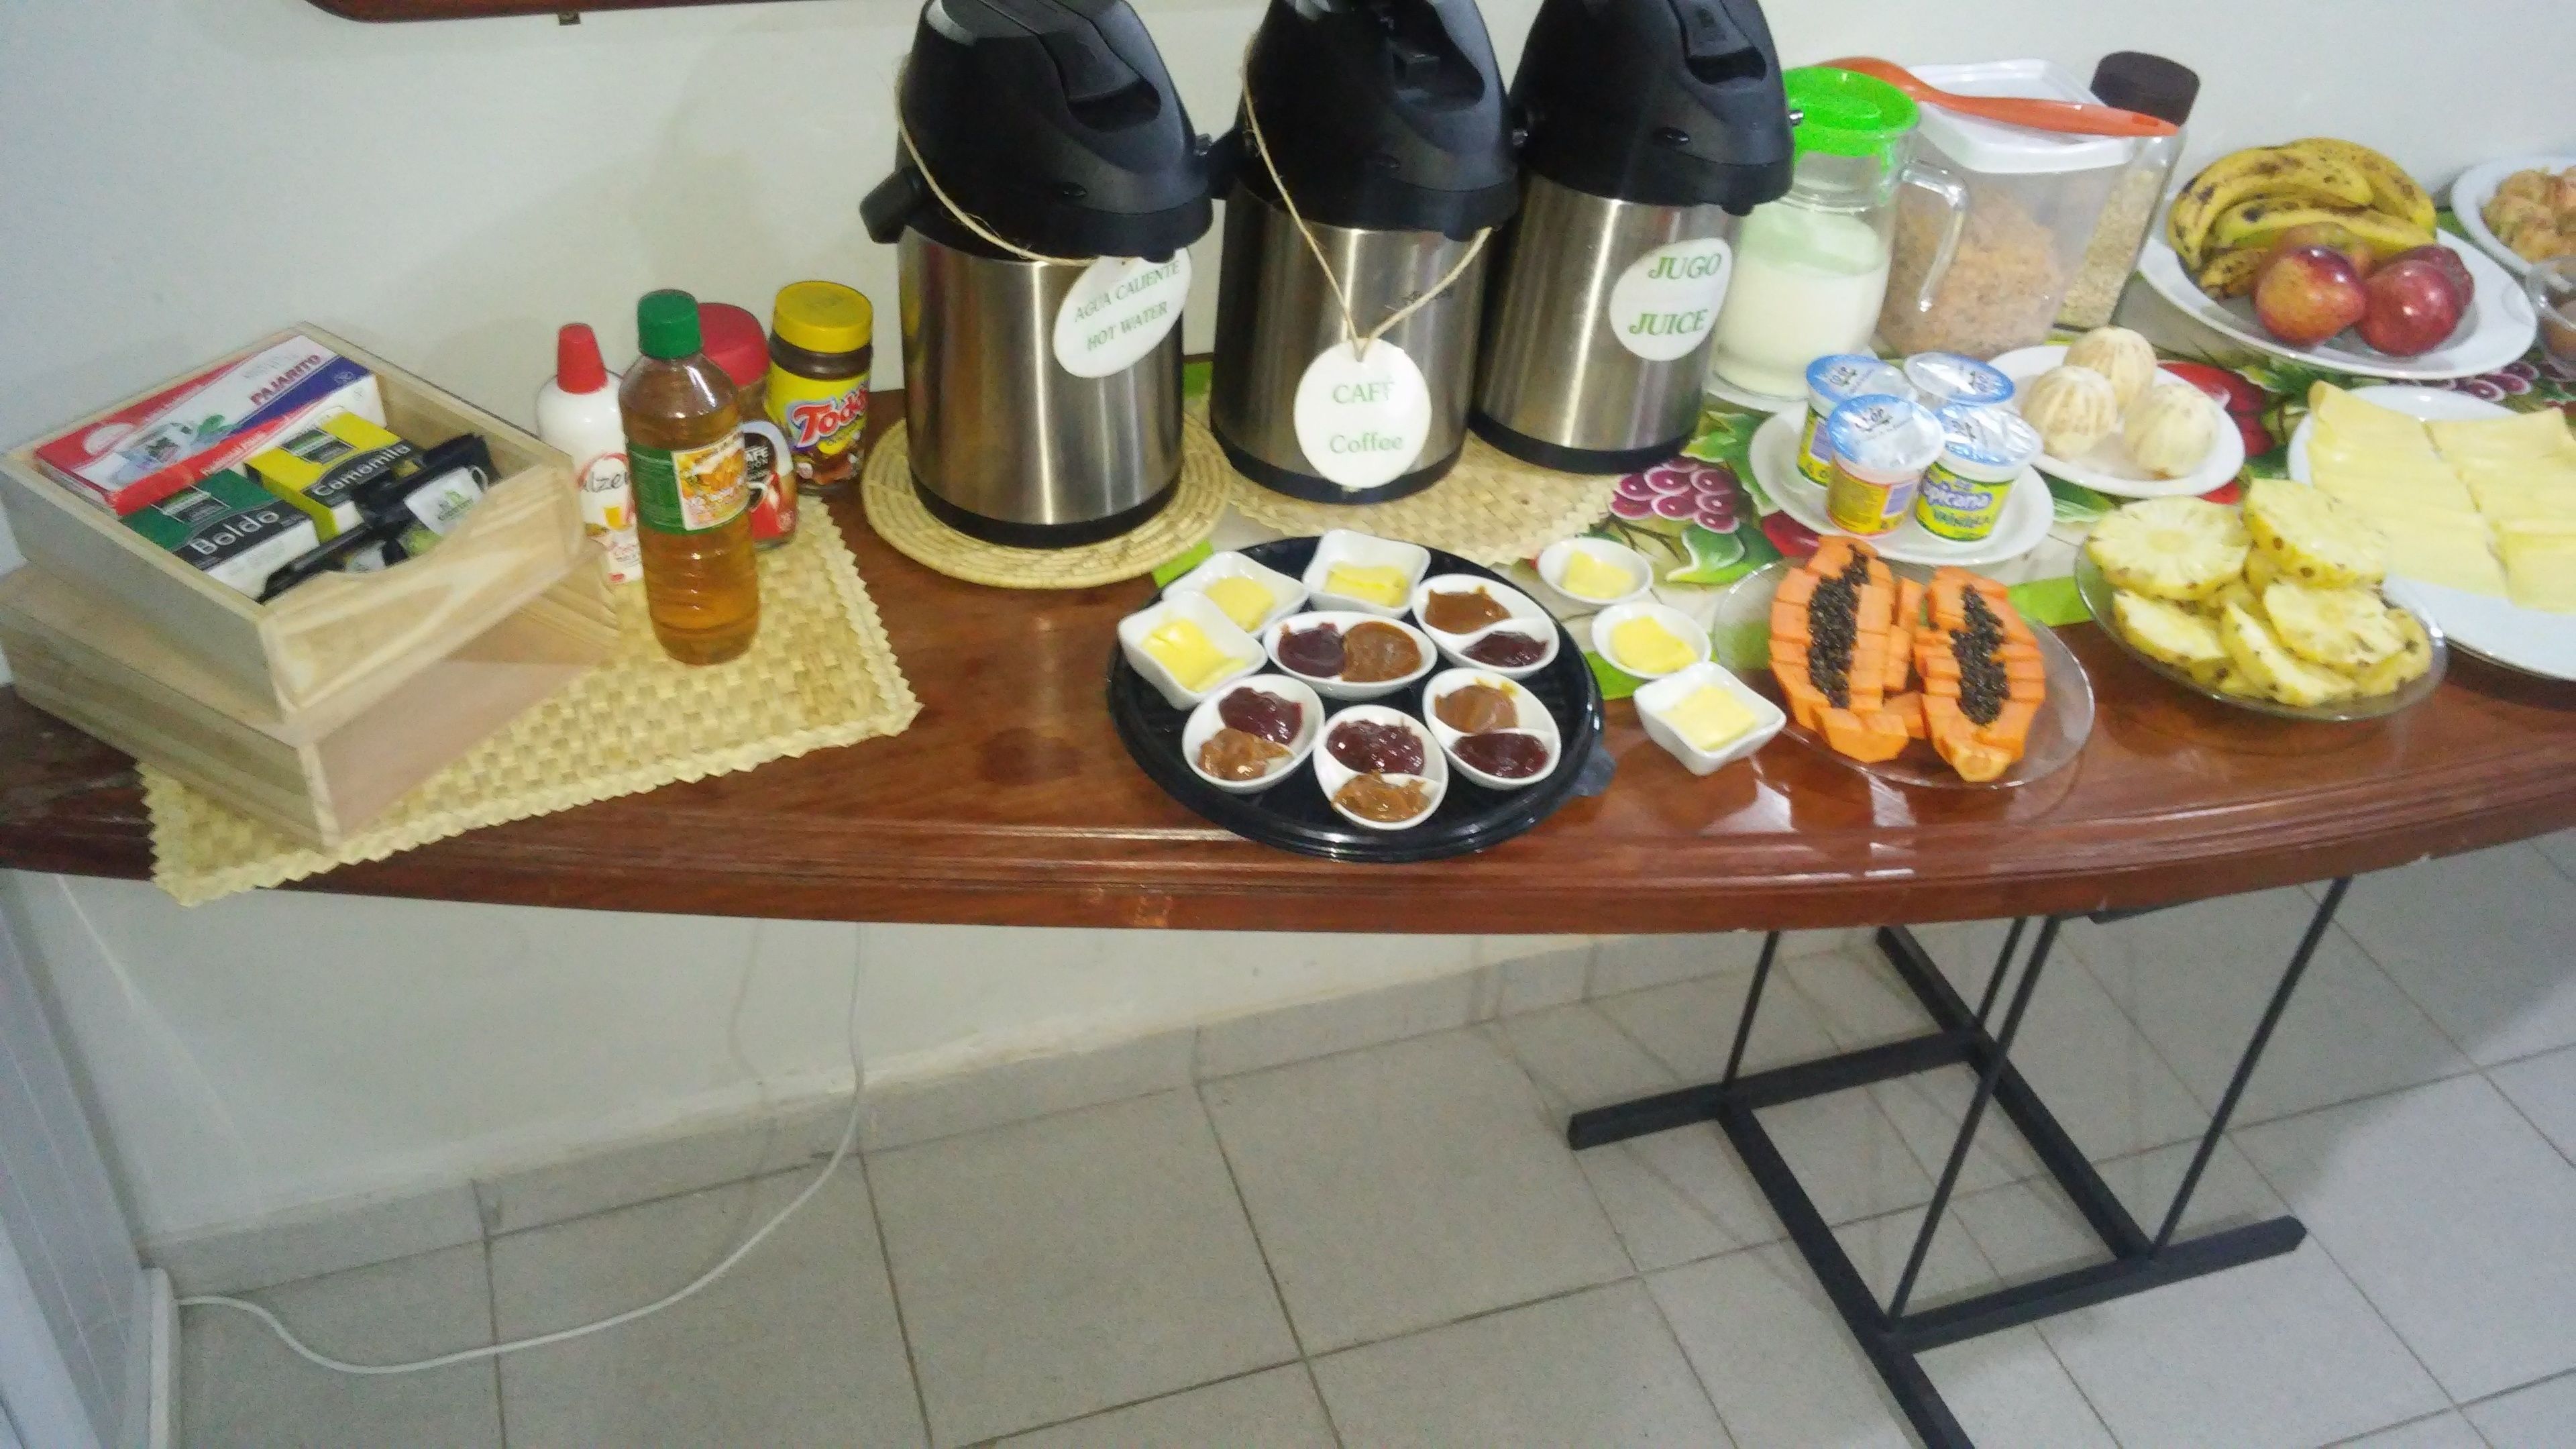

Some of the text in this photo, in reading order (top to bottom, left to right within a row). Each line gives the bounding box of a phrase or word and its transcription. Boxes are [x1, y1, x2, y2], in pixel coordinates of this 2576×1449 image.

[1648, 252, 1722, 280] JUGO
[1075, 260, 1180, 323] AGUA CALIENTE
[1087, 301, 1168, 351] HOT WATER
[1628, 308, 1709, 336] JUICE
[250, 354, 321, 406] PAJARITO
[1330, 431, 1403, 453] Coffee
[311, 443, 411, 496] Camomila
[189, 510, 280, 555] Boldo
